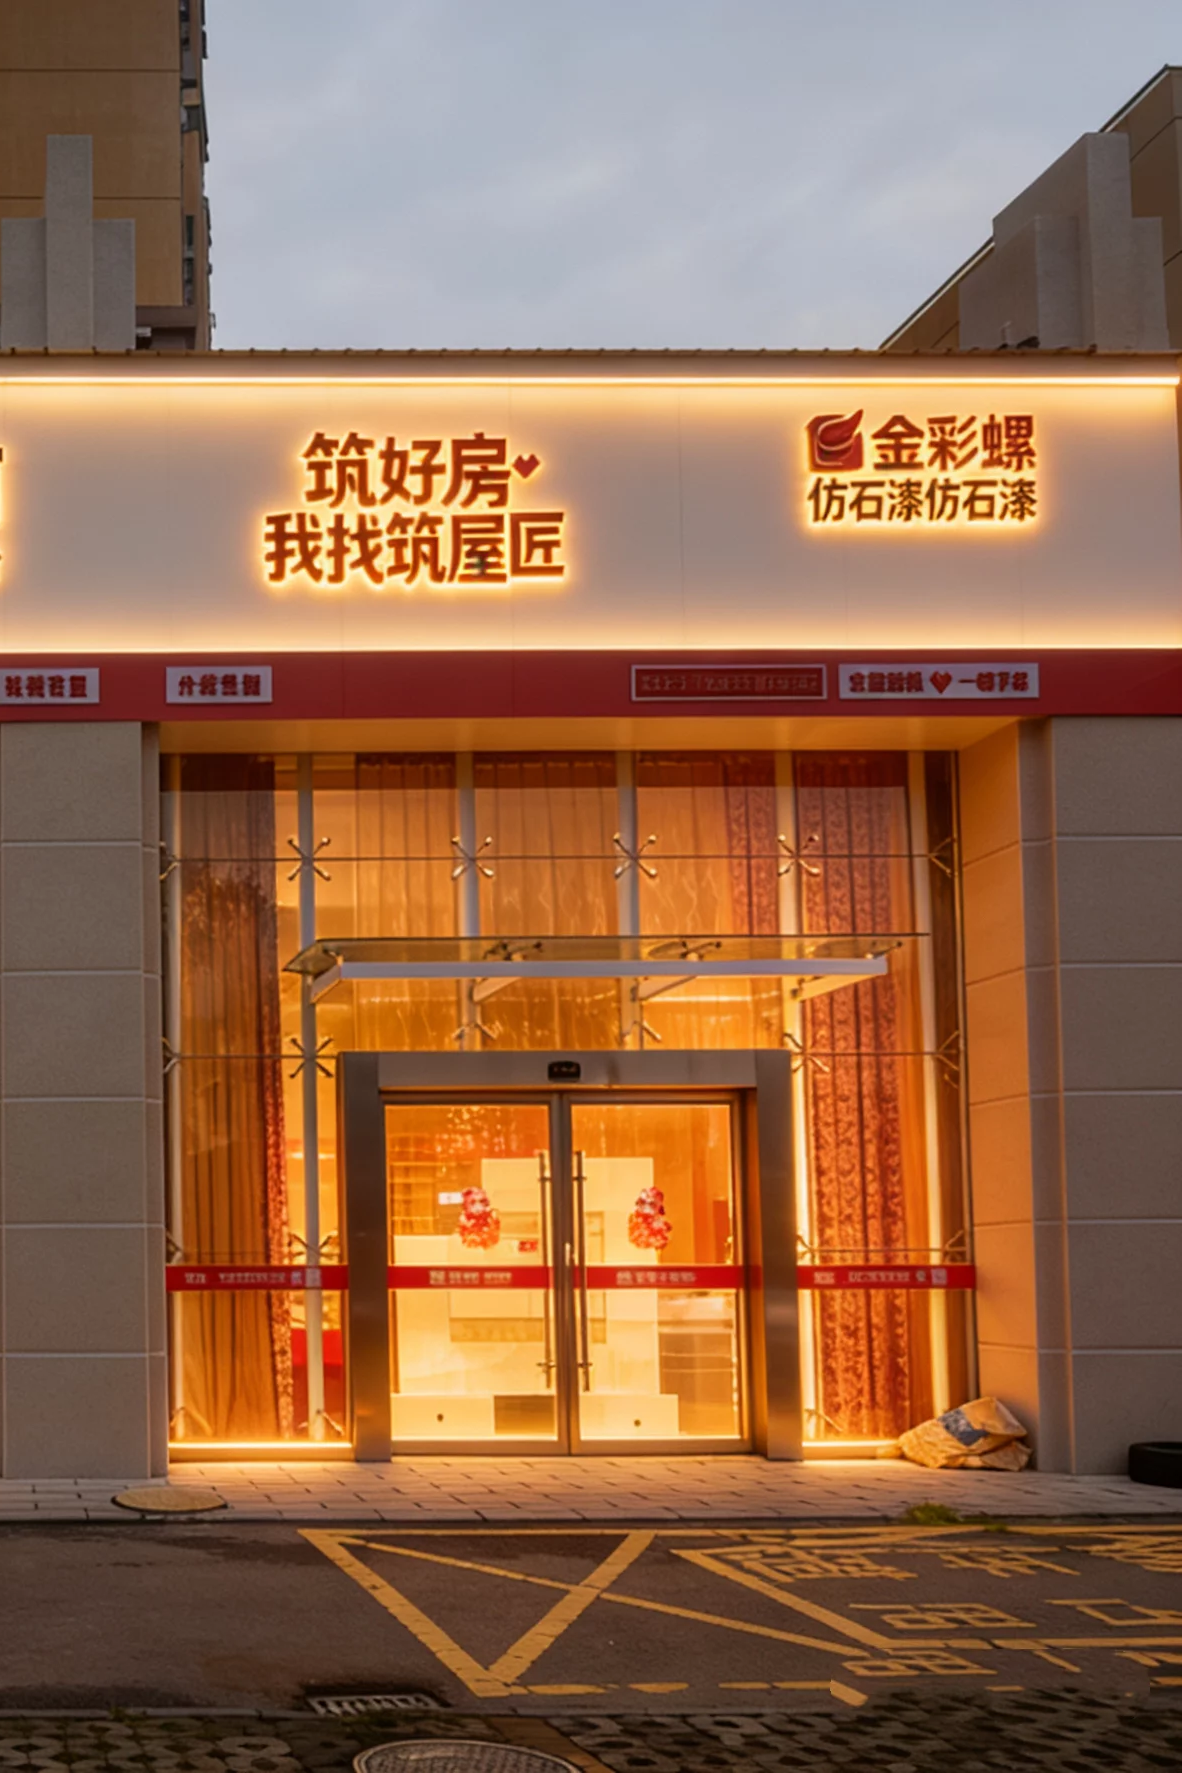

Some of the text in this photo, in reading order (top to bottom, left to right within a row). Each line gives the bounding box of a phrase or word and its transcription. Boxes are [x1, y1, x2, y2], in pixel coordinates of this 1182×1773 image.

[302, 432, 511, 508] 筑好房
[871, 413, 1037, 472] 金彩螺
[807, 477, 1038, 522] 仿石漆仿石漆
[264, 511, 565, 584] 我找筑屋匠
